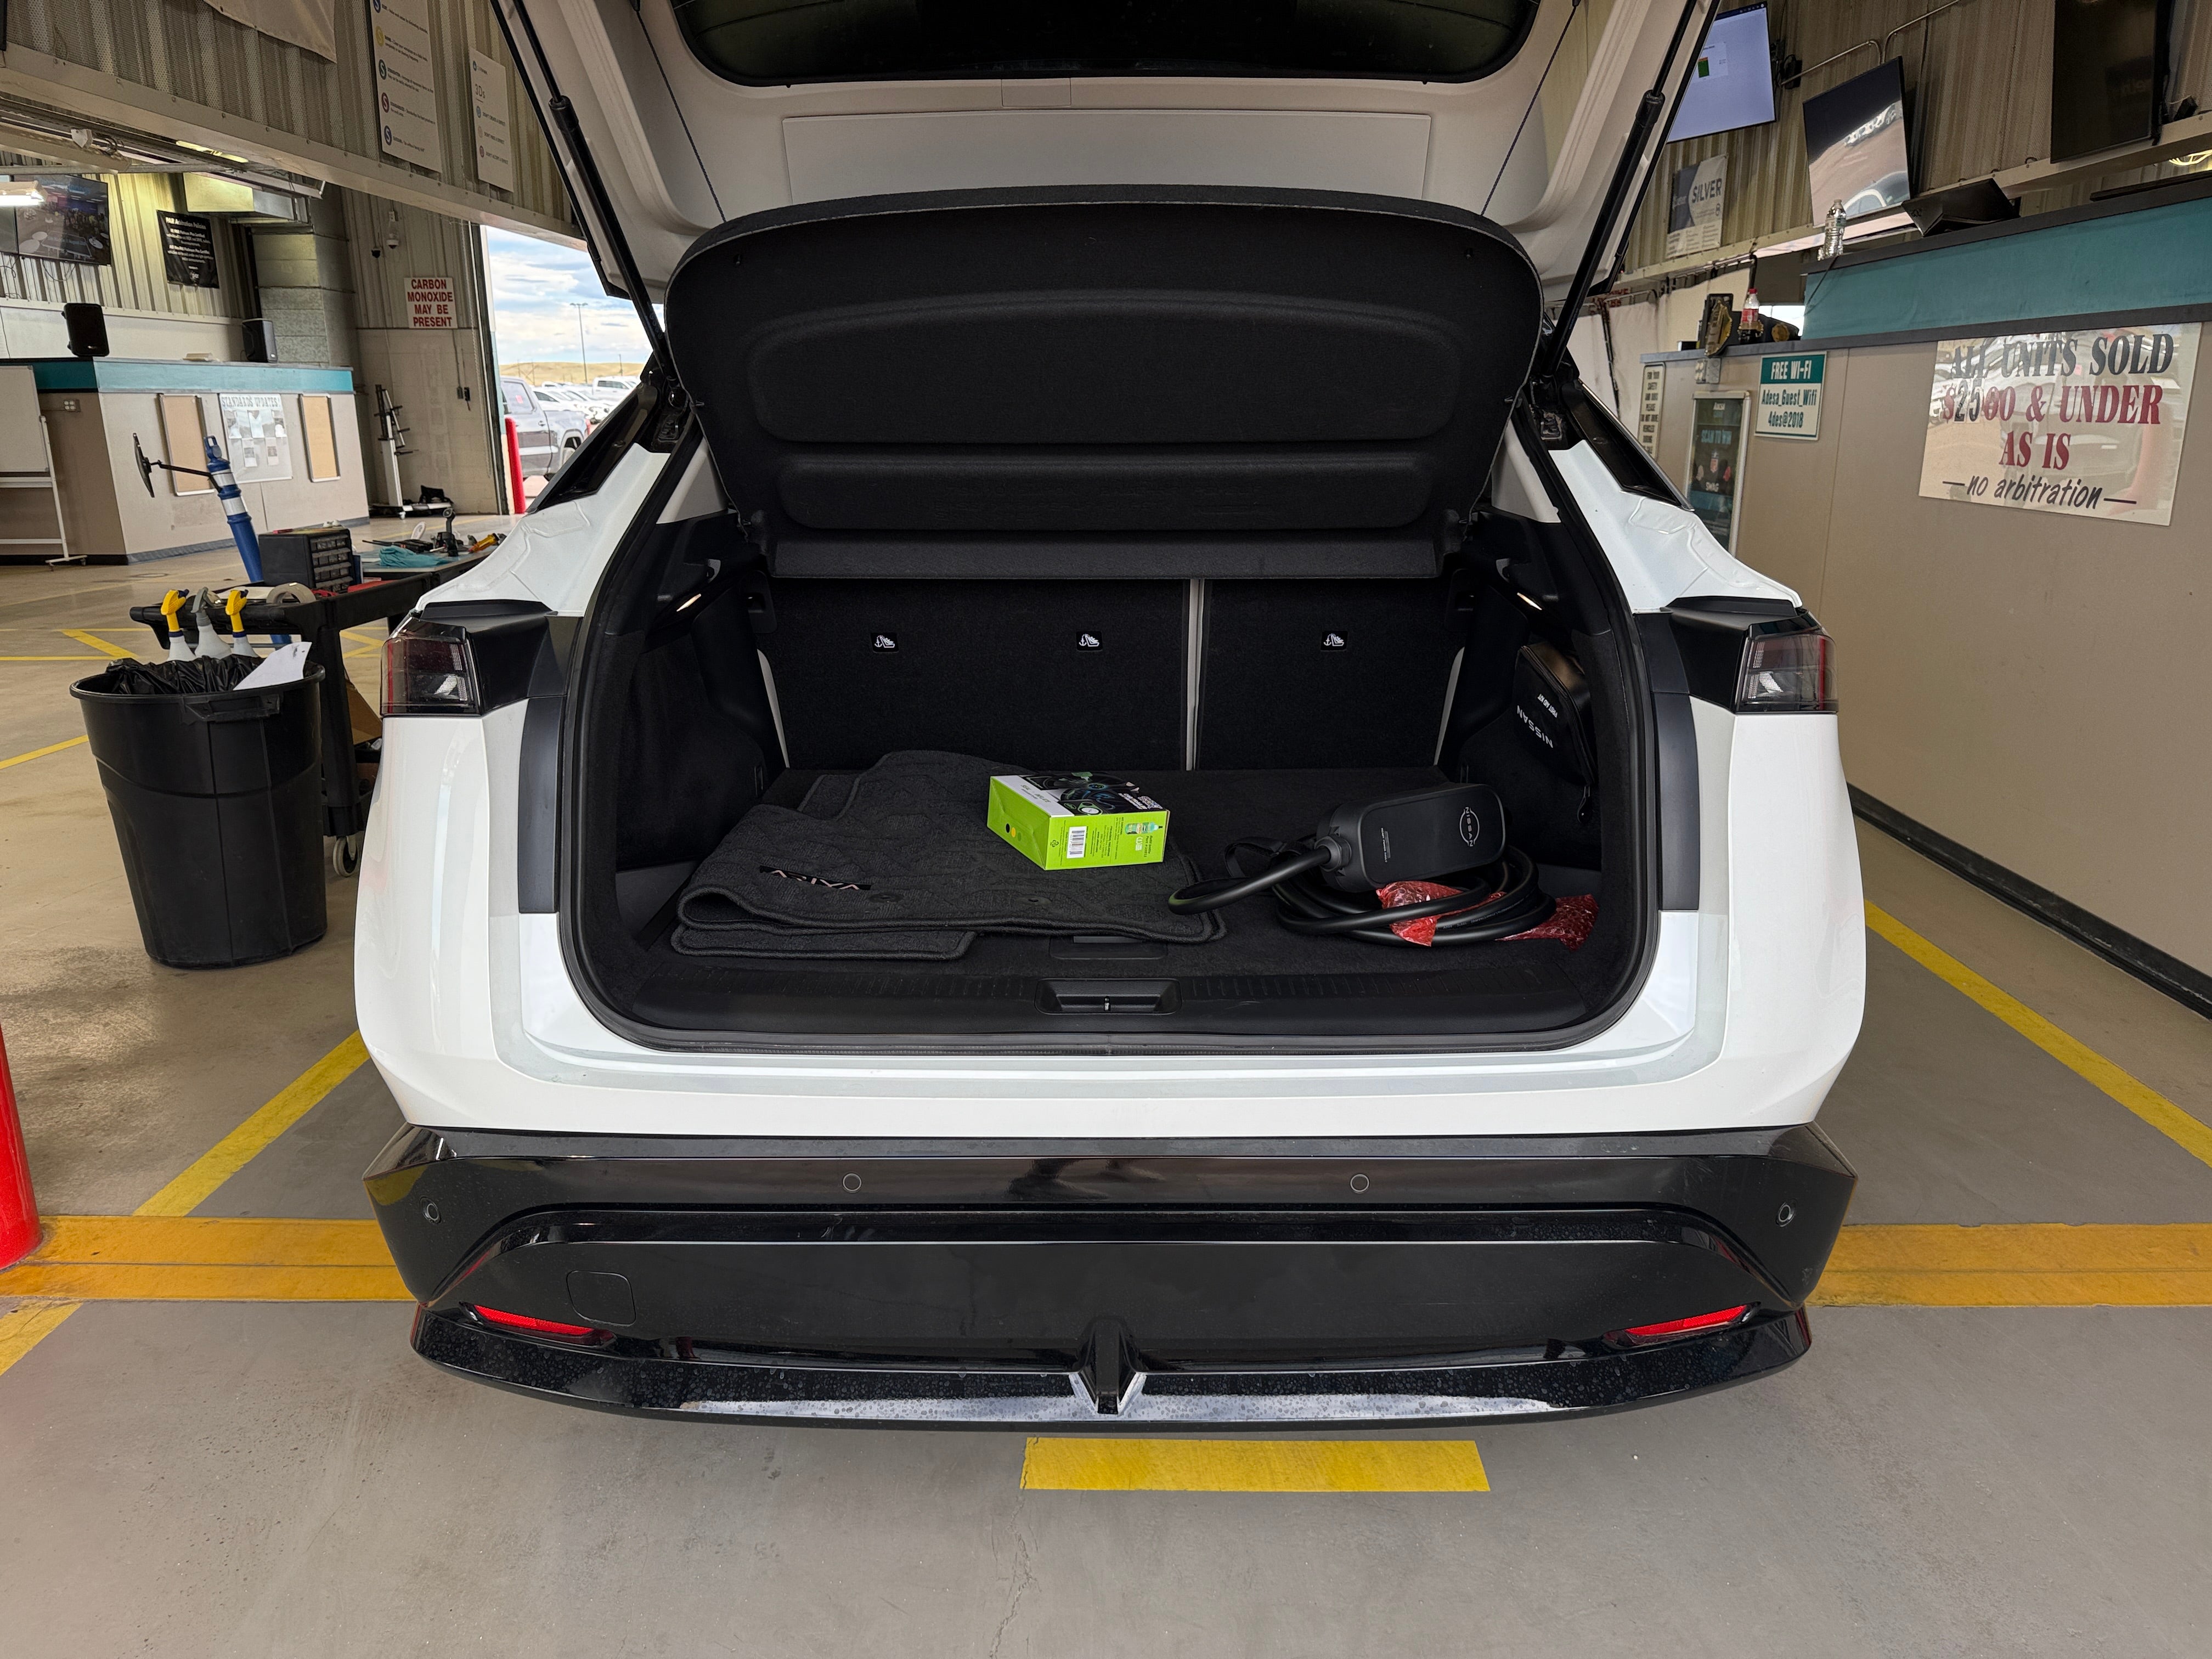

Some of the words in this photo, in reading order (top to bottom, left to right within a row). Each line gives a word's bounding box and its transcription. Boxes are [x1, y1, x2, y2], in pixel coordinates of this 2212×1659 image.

[1692, 178, 1722, 203] SILVER
[411, 279, 447, 289] CARBON
[408, 292, 453, 302] MONOXIDE
[415, 304, 431, 314] MAY
[437, 304, 448, 314] BE
[413, 317, 452, 326] PRESENT
[2002, 339, 2078, 377] UNITS
[2090, 334, 2174, 375] SOLD
[1771, 362, 1788, 380] FREE
[1791, 360, 1812, 379] WI-FI
[2026, 385, 2047, 422] &
[2059, 385, 2163, 424] UNDER
[1768, 411, 1803, 428] 4des@2018
[1999, 431, 2032, 469] AS
[2041, 433, 2070, 470] IS
[1967, 475, 1988, 496] no
[1994, 474, 2103, 509] arbitration
[1517, 705, 1553, 748] NISSAN
[1465, 807, 1474, 847] NISSAN
